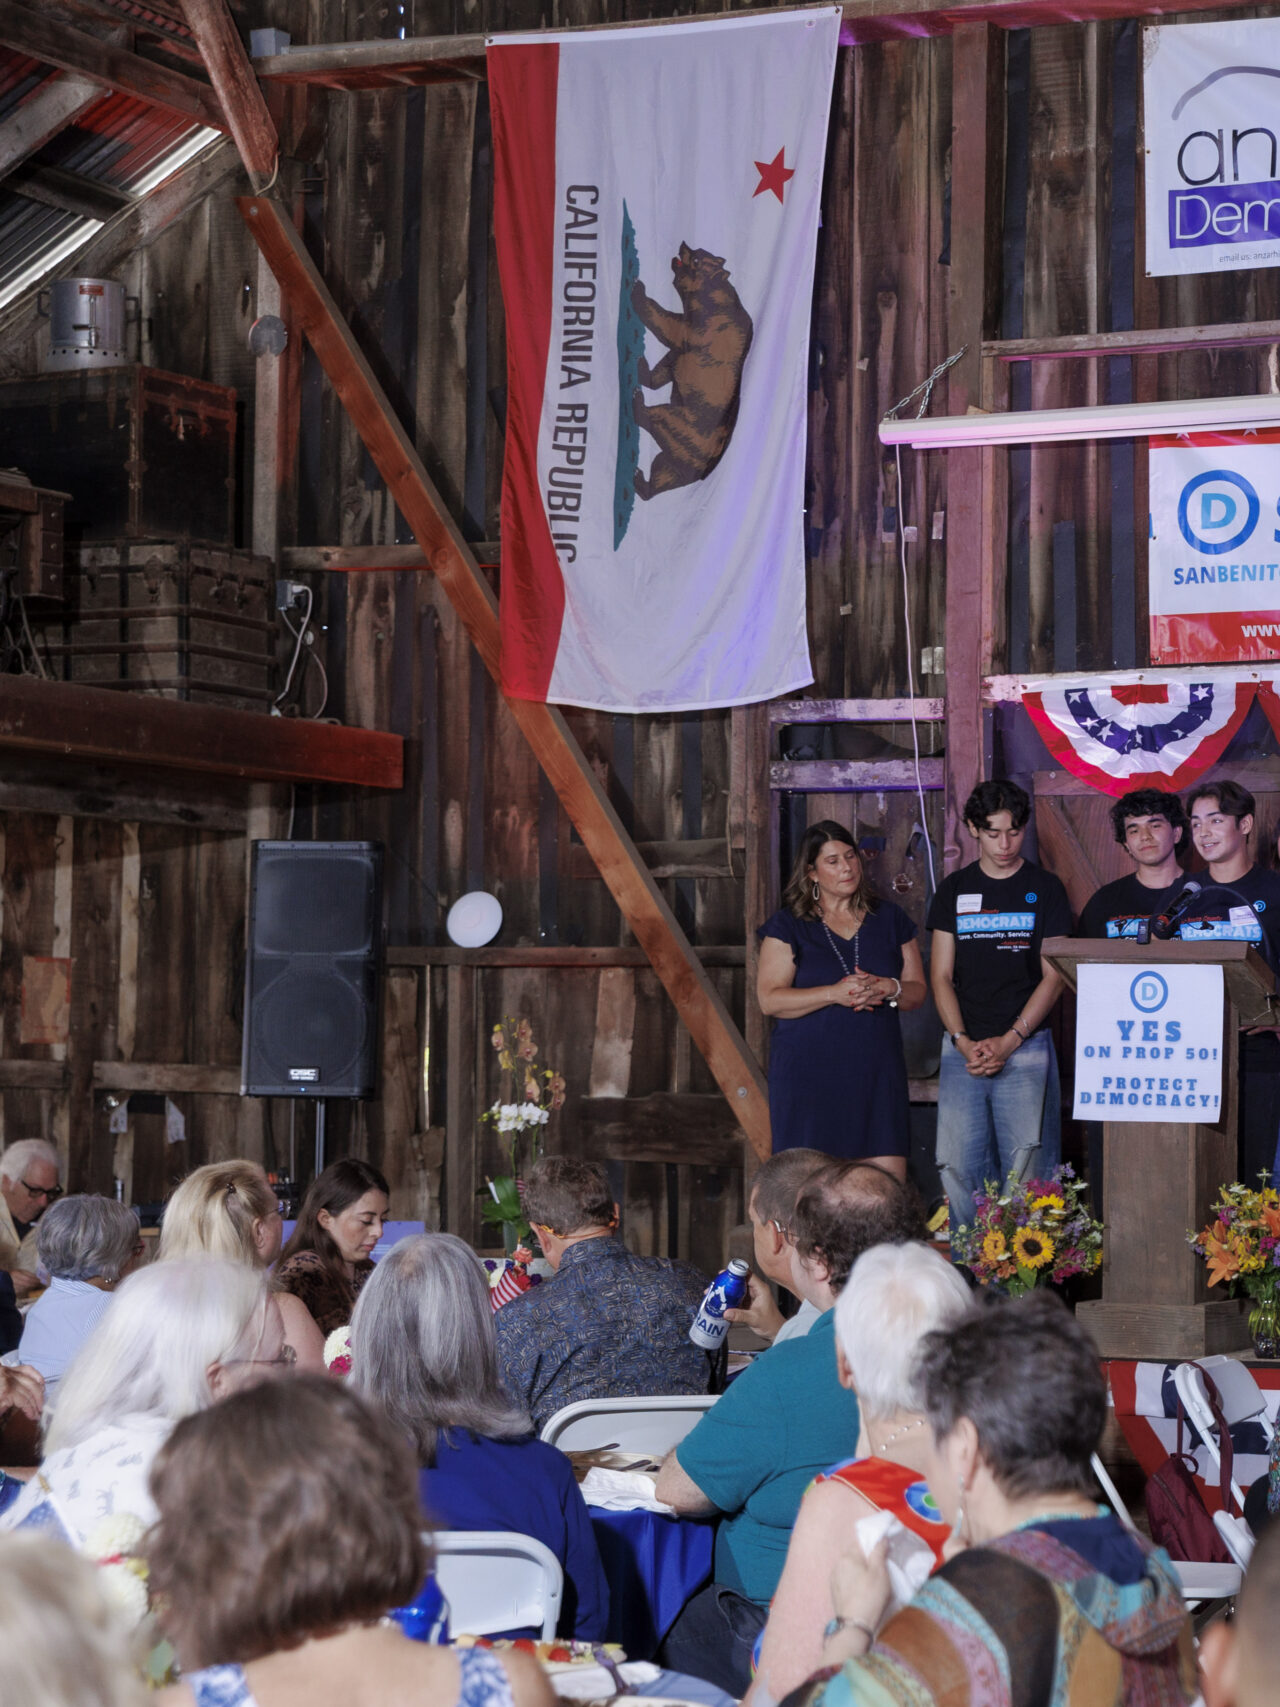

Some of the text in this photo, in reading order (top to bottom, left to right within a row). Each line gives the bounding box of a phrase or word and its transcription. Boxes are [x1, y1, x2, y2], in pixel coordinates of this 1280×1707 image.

[559, 184, 600, 390] CALIFORNIA
[957, 915, 1034, 931] DEMOCRATS
[1116, 1020, 1182, 1042] YES
[1084, 1045, 1218, 1060] ON PROP 50!
[1102, 1076, 1198, 1091] PROTECT
[1080, 1091, 1219, 1107] DEMOCRACY!
